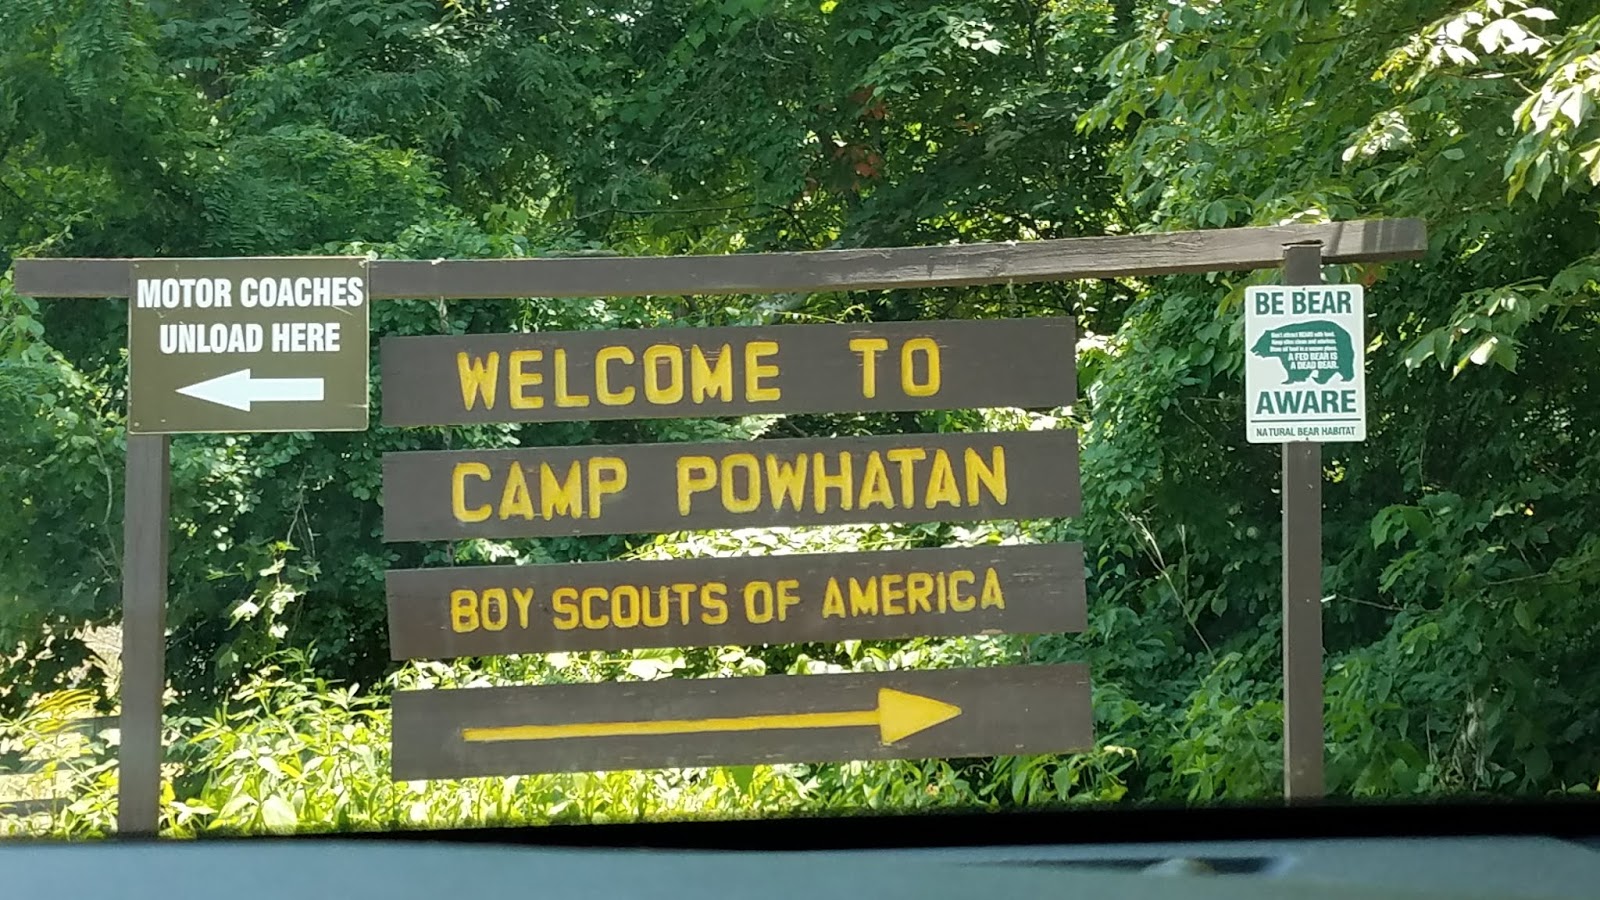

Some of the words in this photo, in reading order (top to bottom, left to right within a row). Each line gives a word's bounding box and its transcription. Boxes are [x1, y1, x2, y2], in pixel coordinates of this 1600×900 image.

[137, 278, 232, 309] MOTOR
[240, 277, 364, 308] COACHES
[1255, 292, 1284, 315] BE
[1292, 291, 1352, 315] BEAR
[160, 323, 263, 354] UNLOAD
[272, 322, 341, 352] HERE
[1288, 352, 1294, 361] A
[1294, 352, 1309, 361] FED
[1310, 352, 1329, 361] BEAR
[1330, 351, 1338, 361] IS
[1290, 361, 1296, 370] A
[1297, 361, 1316, 370] DEAD
[457, 341, 781, 411] WELCOME
[849, 338, 942, 400] TO
[1255, 390, 1357, 415] AWARE
[1256, 427, 1295, 437] NATURAL
[1297, 427, 1320, 437] BEAR
[1322, 426, 1356, 436] HABITAT
[452, 457, 628, 523] CAMP
[677, 446, 1008, 516] POWHATAN
[451, 588, 534, 633] BOY
[552, 582, 729, 631] SCOUTS
[744, 580, 801, 624] OF
[822, 568, 1006, 619] AMERICA
